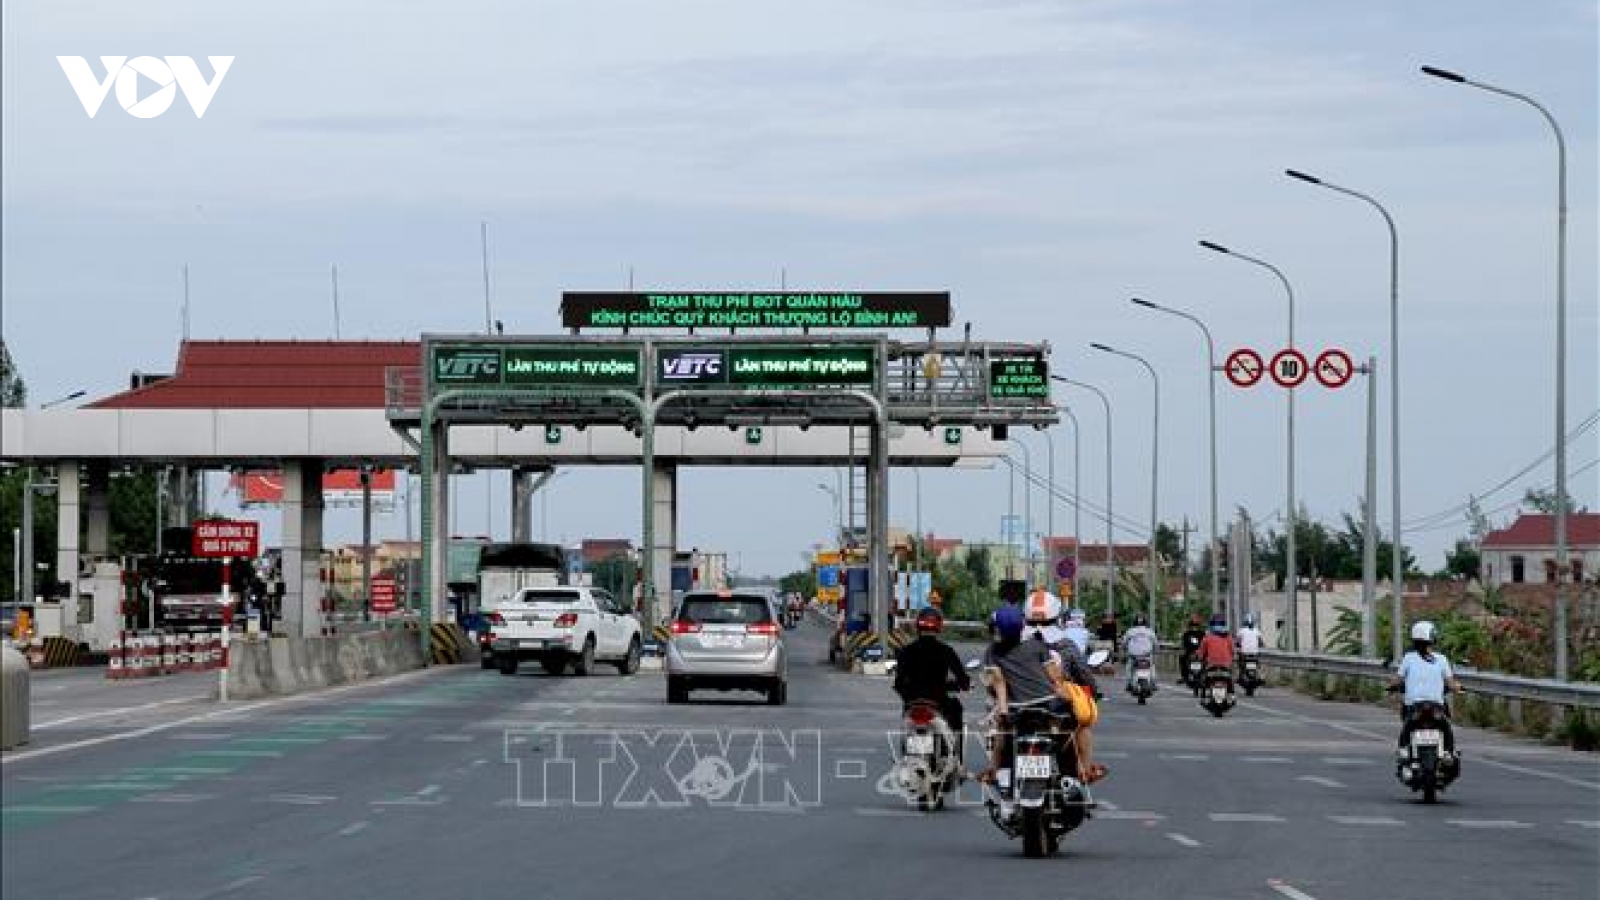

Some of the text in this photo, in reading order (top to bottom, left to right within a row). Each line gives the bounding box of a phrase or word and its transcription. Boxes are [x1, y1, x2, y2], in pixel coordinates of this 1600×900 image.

[694, 294, 723, 308] THU
[727, 293, 749, 308] PHÍ
[753, 294, 783, 308] BOT
[630, 309, 670, 325] CHÚC
[709, 309, 760, 325] KHÁCH
[437, 355, 499, 378] VETC
[507, 358, 533, 373] LÀN
[533, 360, 559, 373] THU
[560, 358, 581, 373] PHÍ
[600, 358, 637, 376] ĐỘNG
[663, 355, 722, 378] VETC
[761, 360, 787, 373] THU
[788, 358, 812, 373] PHÍ
[1280, 360, 1298, 378] 10
